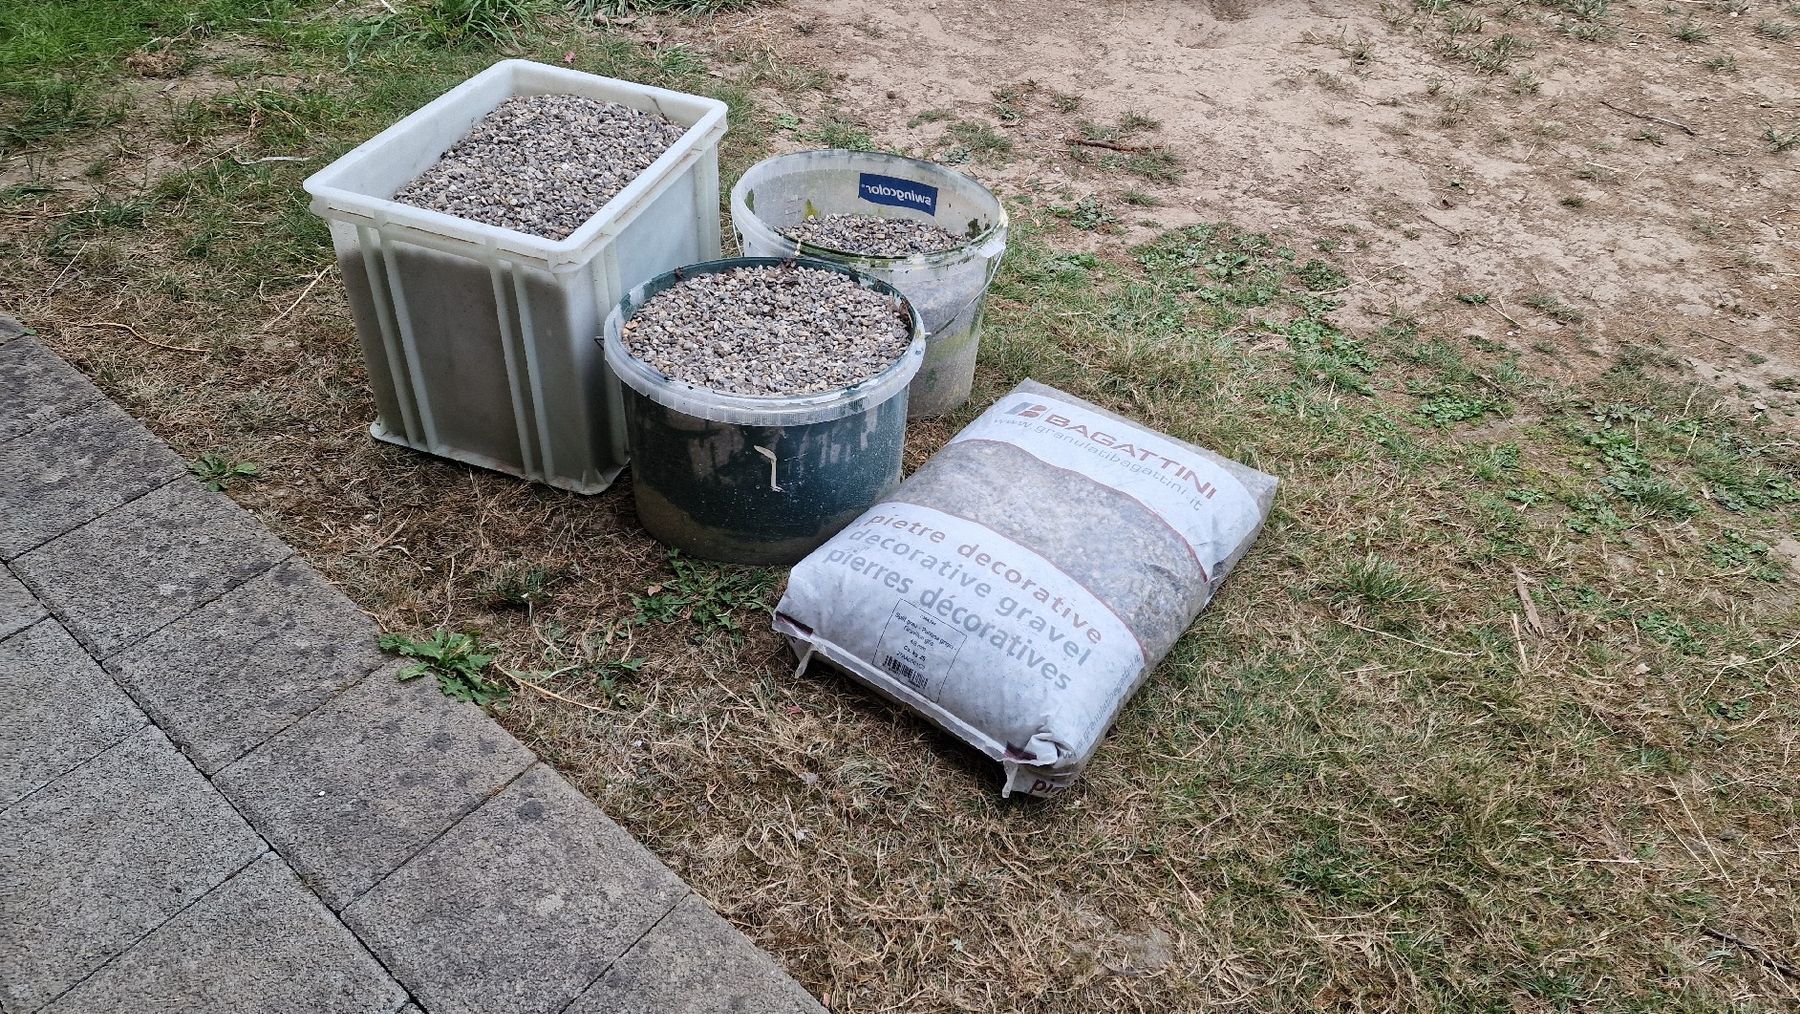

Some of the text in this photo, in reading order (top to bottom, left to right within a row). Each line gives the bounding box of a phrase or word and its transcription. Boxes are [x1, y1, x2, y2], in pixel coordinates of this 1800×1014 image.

[1044, 414, 1217, 500] BAGATTINI
[822, 549, 1072, 690] pierres décoratives
[848, 529, 1091, 666] decorative gravel
[864, 515, 1102, 644] pietre decorative
